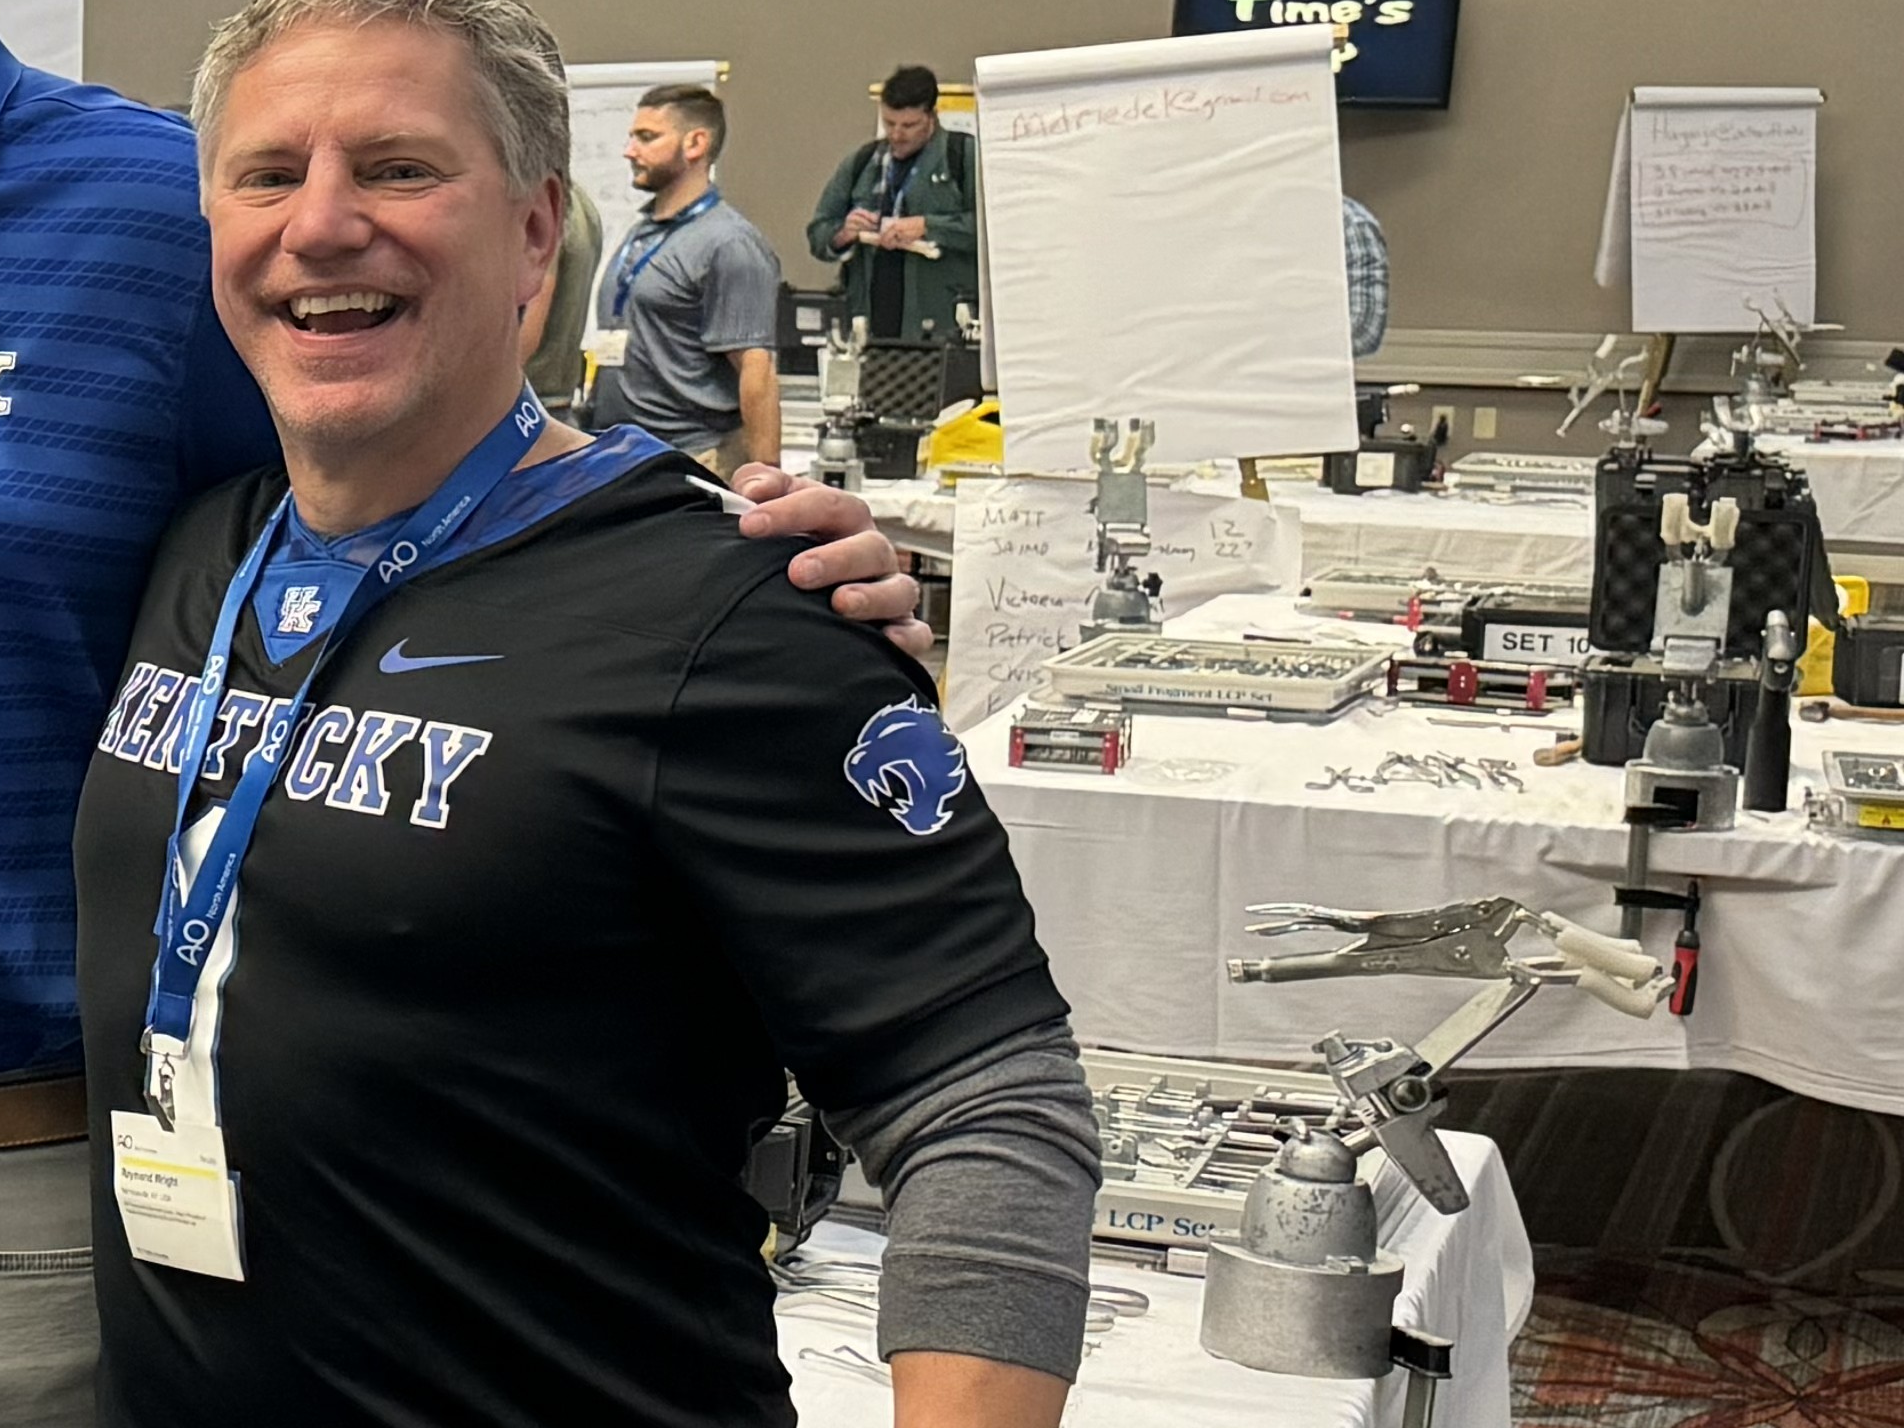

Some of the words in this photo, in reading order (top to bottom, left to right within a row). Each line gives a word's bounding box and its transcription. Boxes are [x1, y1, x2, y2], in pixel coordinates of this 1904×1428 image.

[378, 539, 419, 585] AO
[1501, 631, 1555, 653] SET
[175, 918, 210, 966] AO
[205, 891, 223, 920] North
[215, 852, 237, 893] America
[1109, 1209, 1165, 1232] LCP
